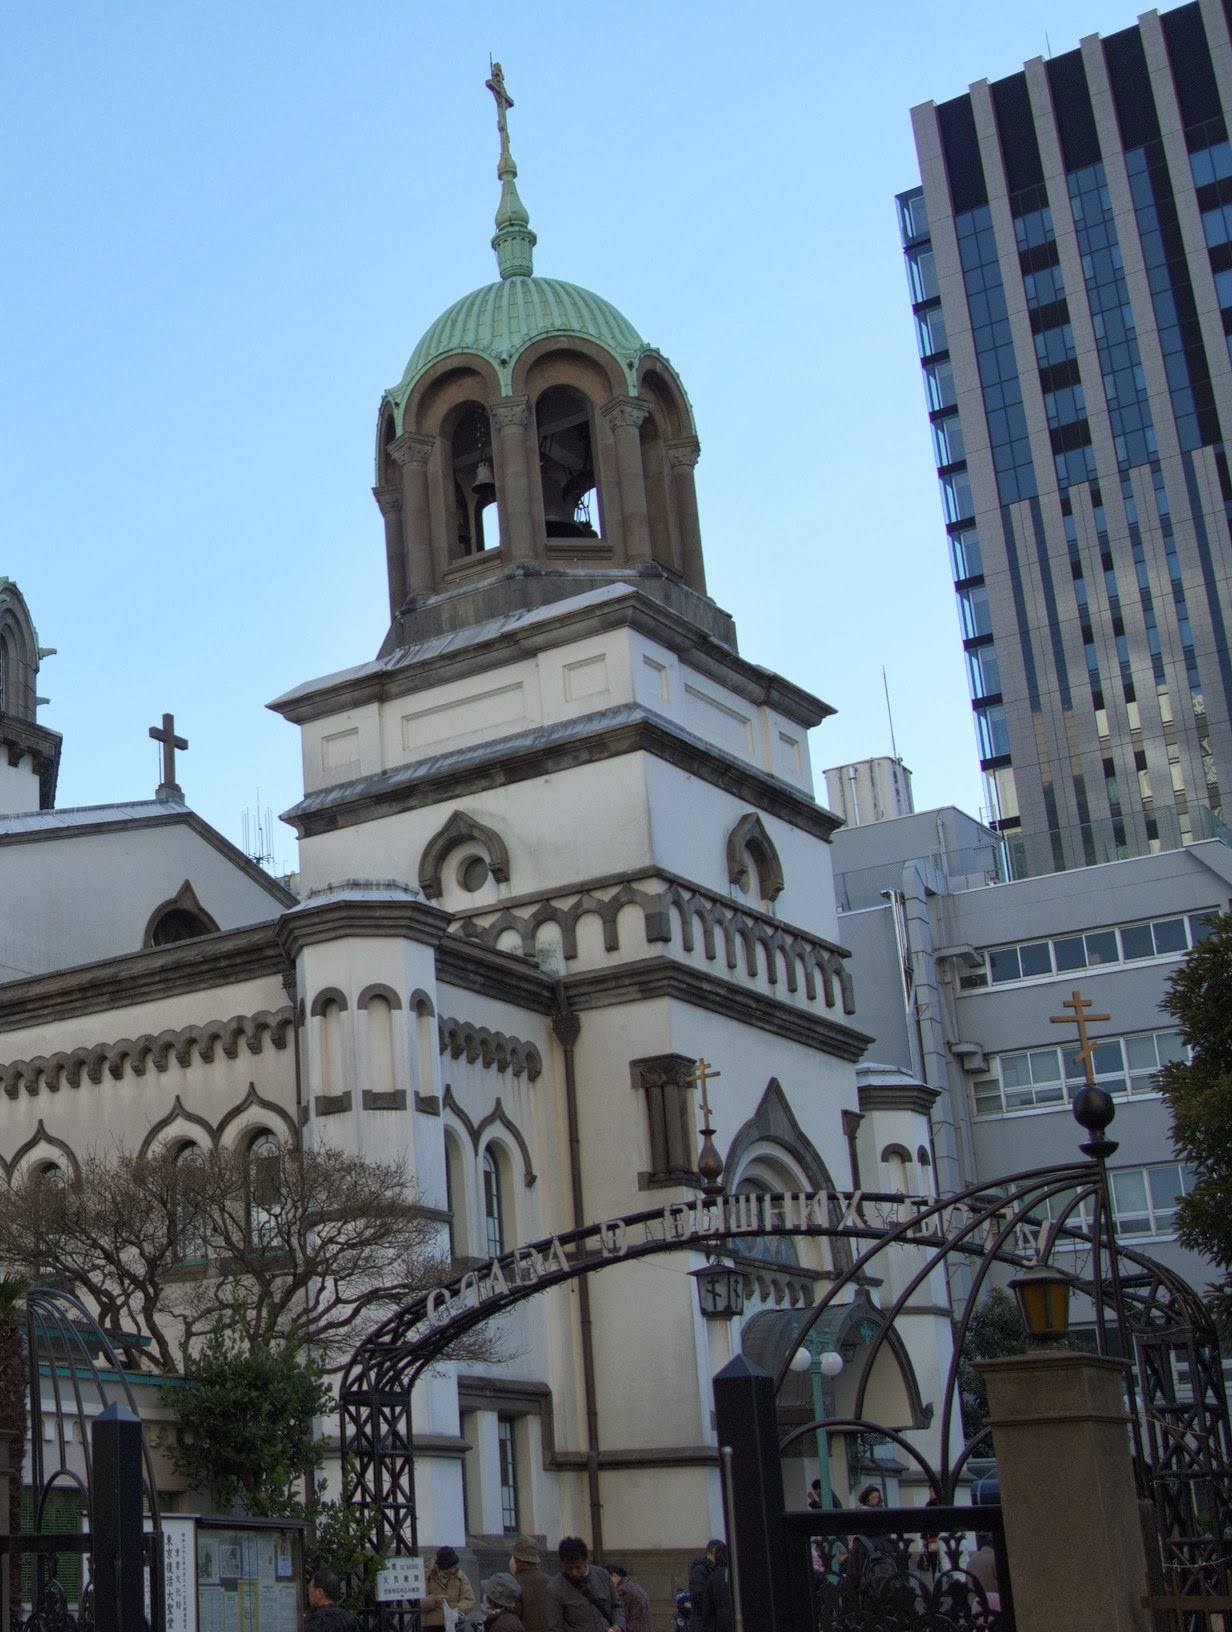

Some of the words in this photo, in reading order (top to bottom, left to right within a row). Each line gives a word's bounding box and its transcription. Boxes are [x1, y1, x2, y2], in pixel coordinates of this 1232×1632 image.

[427, 1236, 570, 1326] СЛАВА
[600, 1219, 628, 1257] В
[664, 1190, 866, 1243] ВЫШНИХ
[165, 1533, 174, 1629] 東京復活大聖堂
